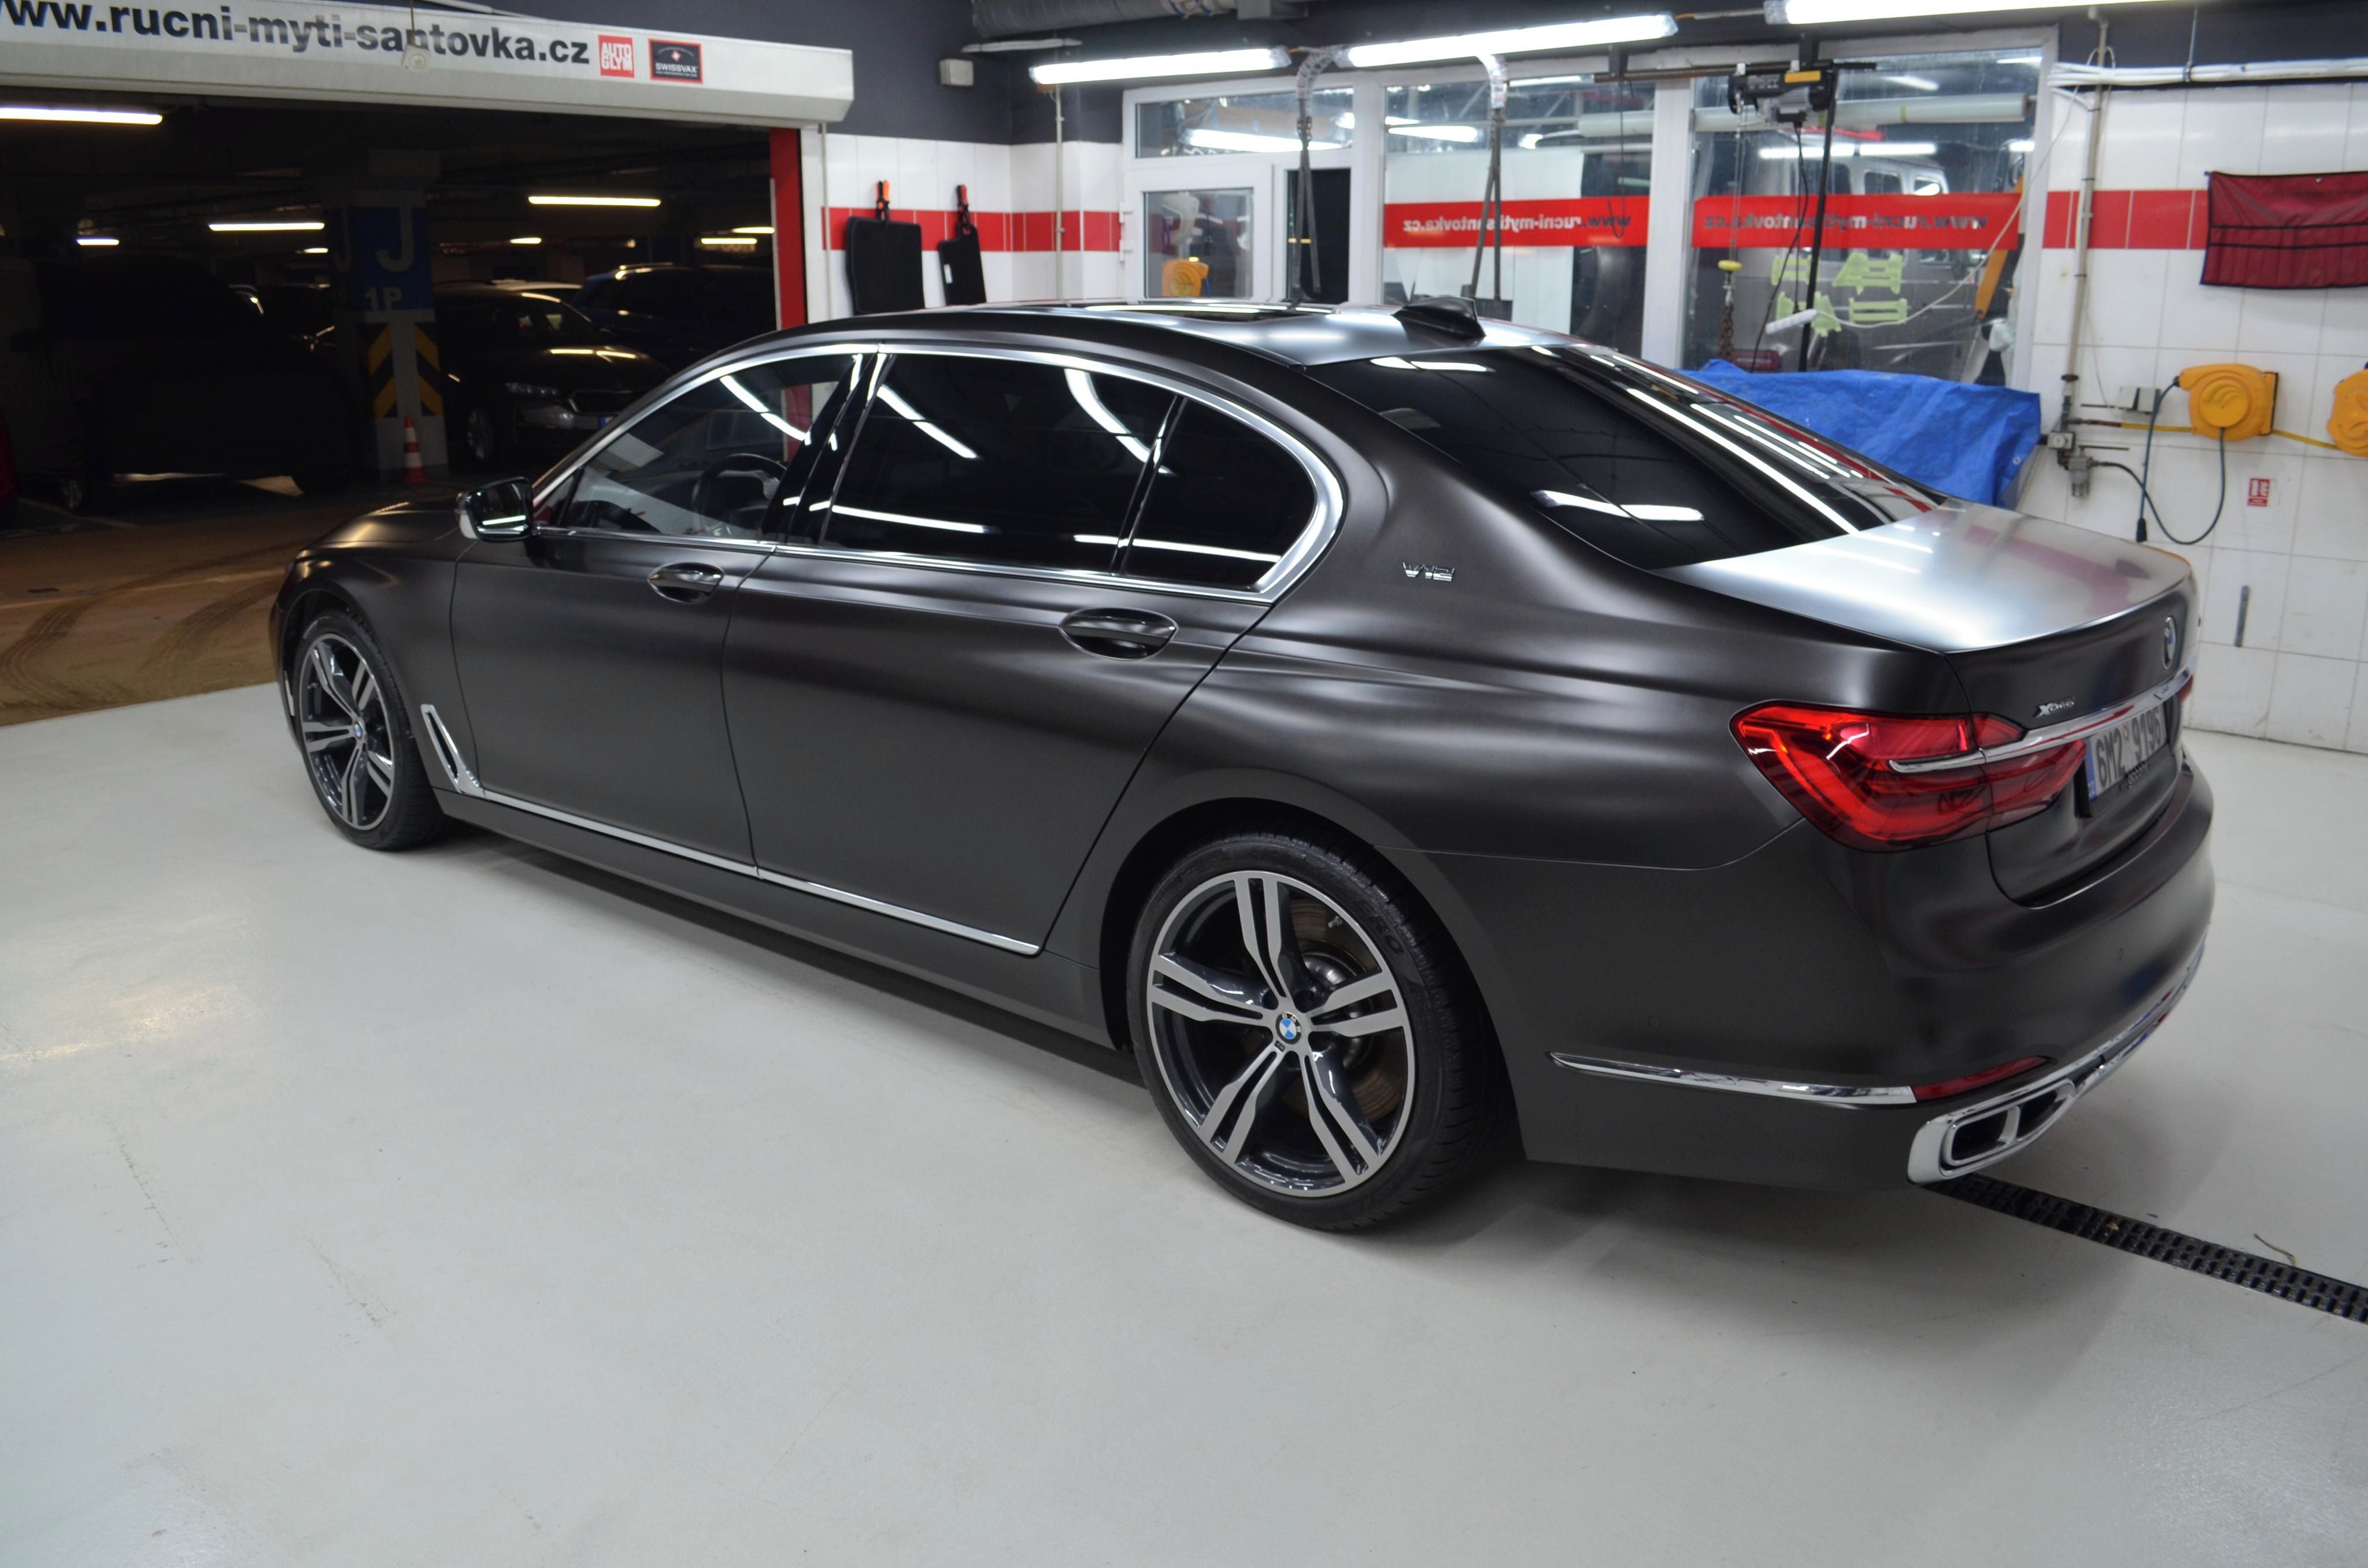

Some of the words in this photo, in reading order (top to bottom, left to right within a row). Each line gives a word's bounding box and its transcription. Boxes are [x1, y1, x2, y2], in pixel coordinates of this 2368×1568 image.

[0, 0, 590, 64] ww.rucni-myti-santovka.cz
[601, 42, 632, 58] AUTO
[601, 56, 633, 71] GLYM
[655, 62, 697, 73] SWISSVAX
[1403, 562, 1455, 582] V12
[2096, 727, 2126, 788] 6M2
